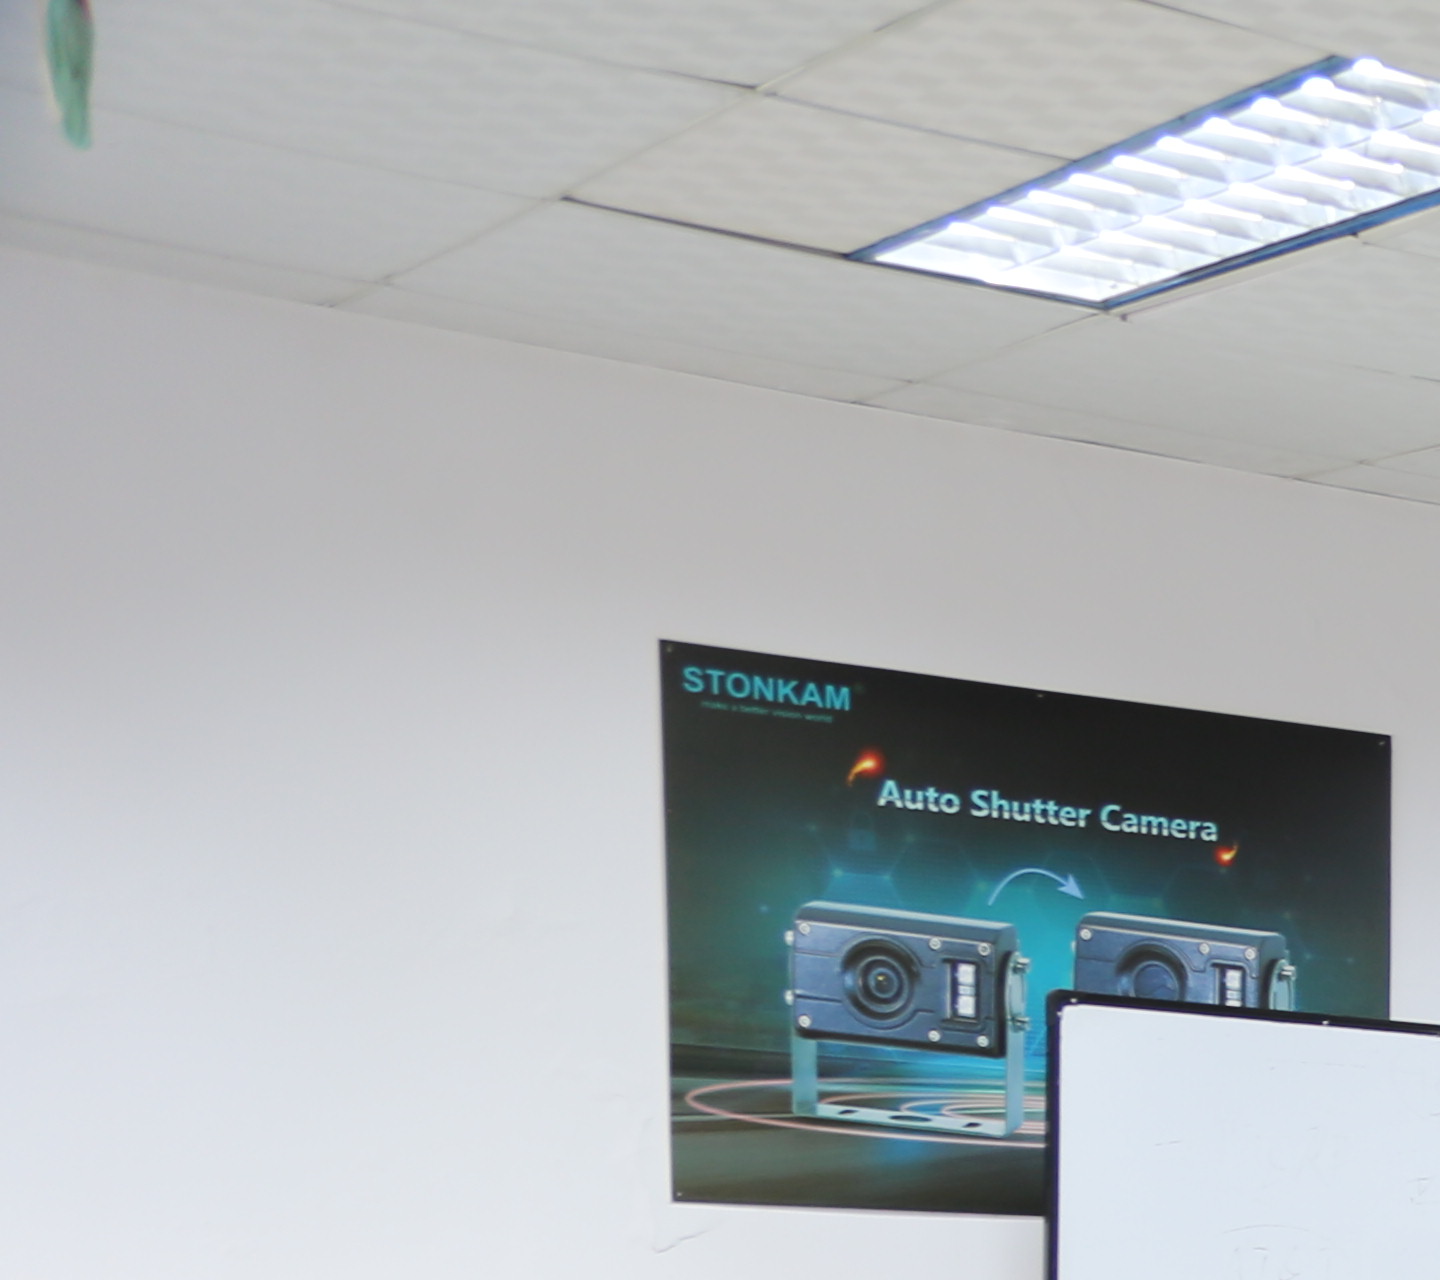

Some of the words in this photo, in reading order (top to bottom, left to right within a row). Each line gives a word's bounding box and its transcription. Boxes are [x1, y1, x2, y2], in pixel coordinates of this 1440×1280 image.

[683, 666, 850, 711] STONKAM
[877, 779, 960, 814] Auto
[970, 789, 1092, 828] Shutter
[1100, 804, 1219, 842] Camera
